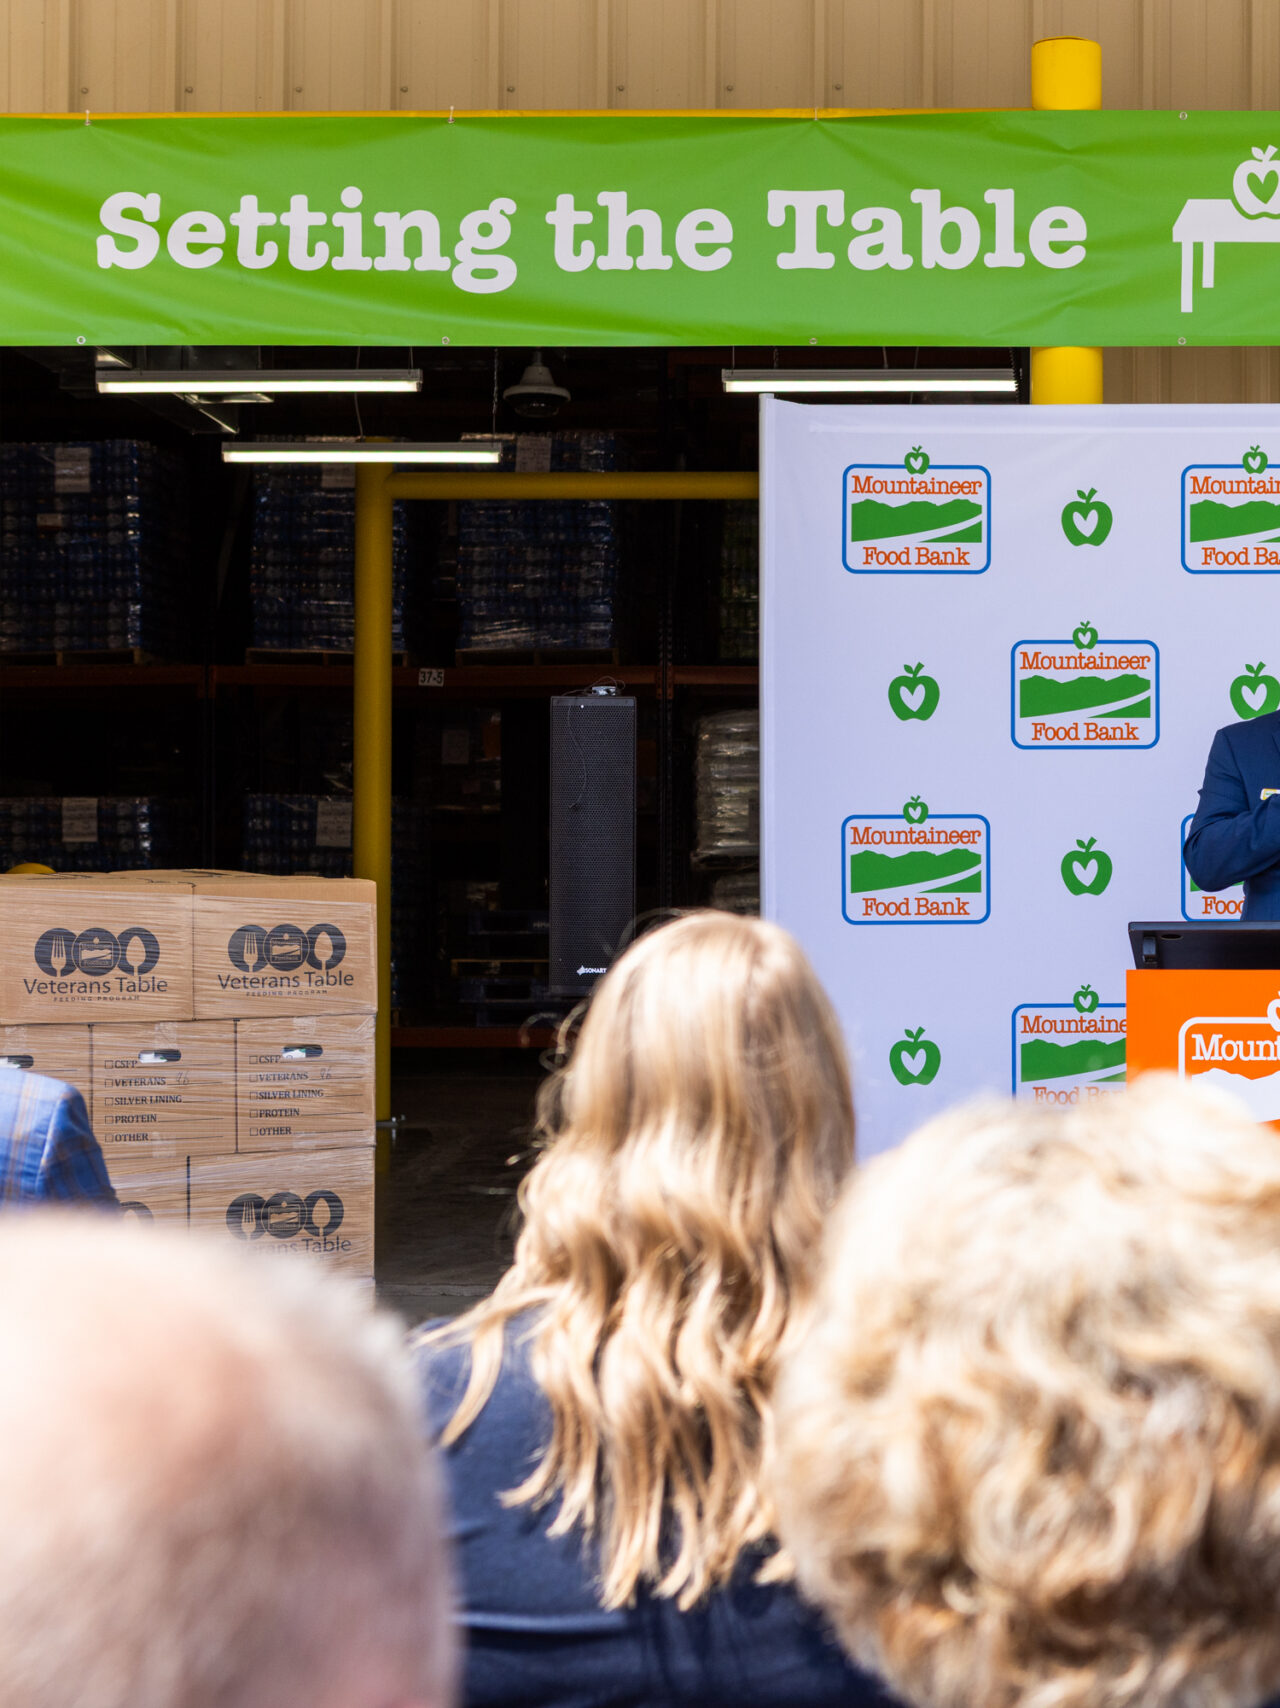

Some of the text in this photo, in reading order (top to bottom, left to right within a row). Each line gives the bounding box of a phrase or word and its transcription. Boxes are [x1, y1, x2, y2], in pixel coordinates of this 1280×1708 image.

[96, 186, 518, 294] Setting
[545, 190, 734, 273] the
[767, 188, 1087, 271] Table
[851, 474, 983, 496] Mountaineer
[861, 546, 970, 567] Food Bank
[1200, 546, 1251, 566] Food
[1019, 650, 1152, 671] Mountaineer
[1031, 721, 1140, 742] Food Bank
[849, 826, 982, 846] Mountaineer
[861, 896, 971, 917] Food Bank
[23, 976, 168, 995] Veterans Table
[217, 970, 354, 990] Veterans Table
[114, 1077, 166, 1087] VETERANS
[259, 1072, 309, 1082] VETERANS
[114, 1095, 182, 1106] SILVER LINING
[258, 1089, 324, 1100] SILVER LINING
[114, 1114, 157, 1124] PROTEIN
[259, 1108, 300, 1118] PROTEIN
[114, 1133, 149, 1142] OTHER
[259, 1127, 292, 1136] OTHER
[302, 1235, 352, 1253] Table
